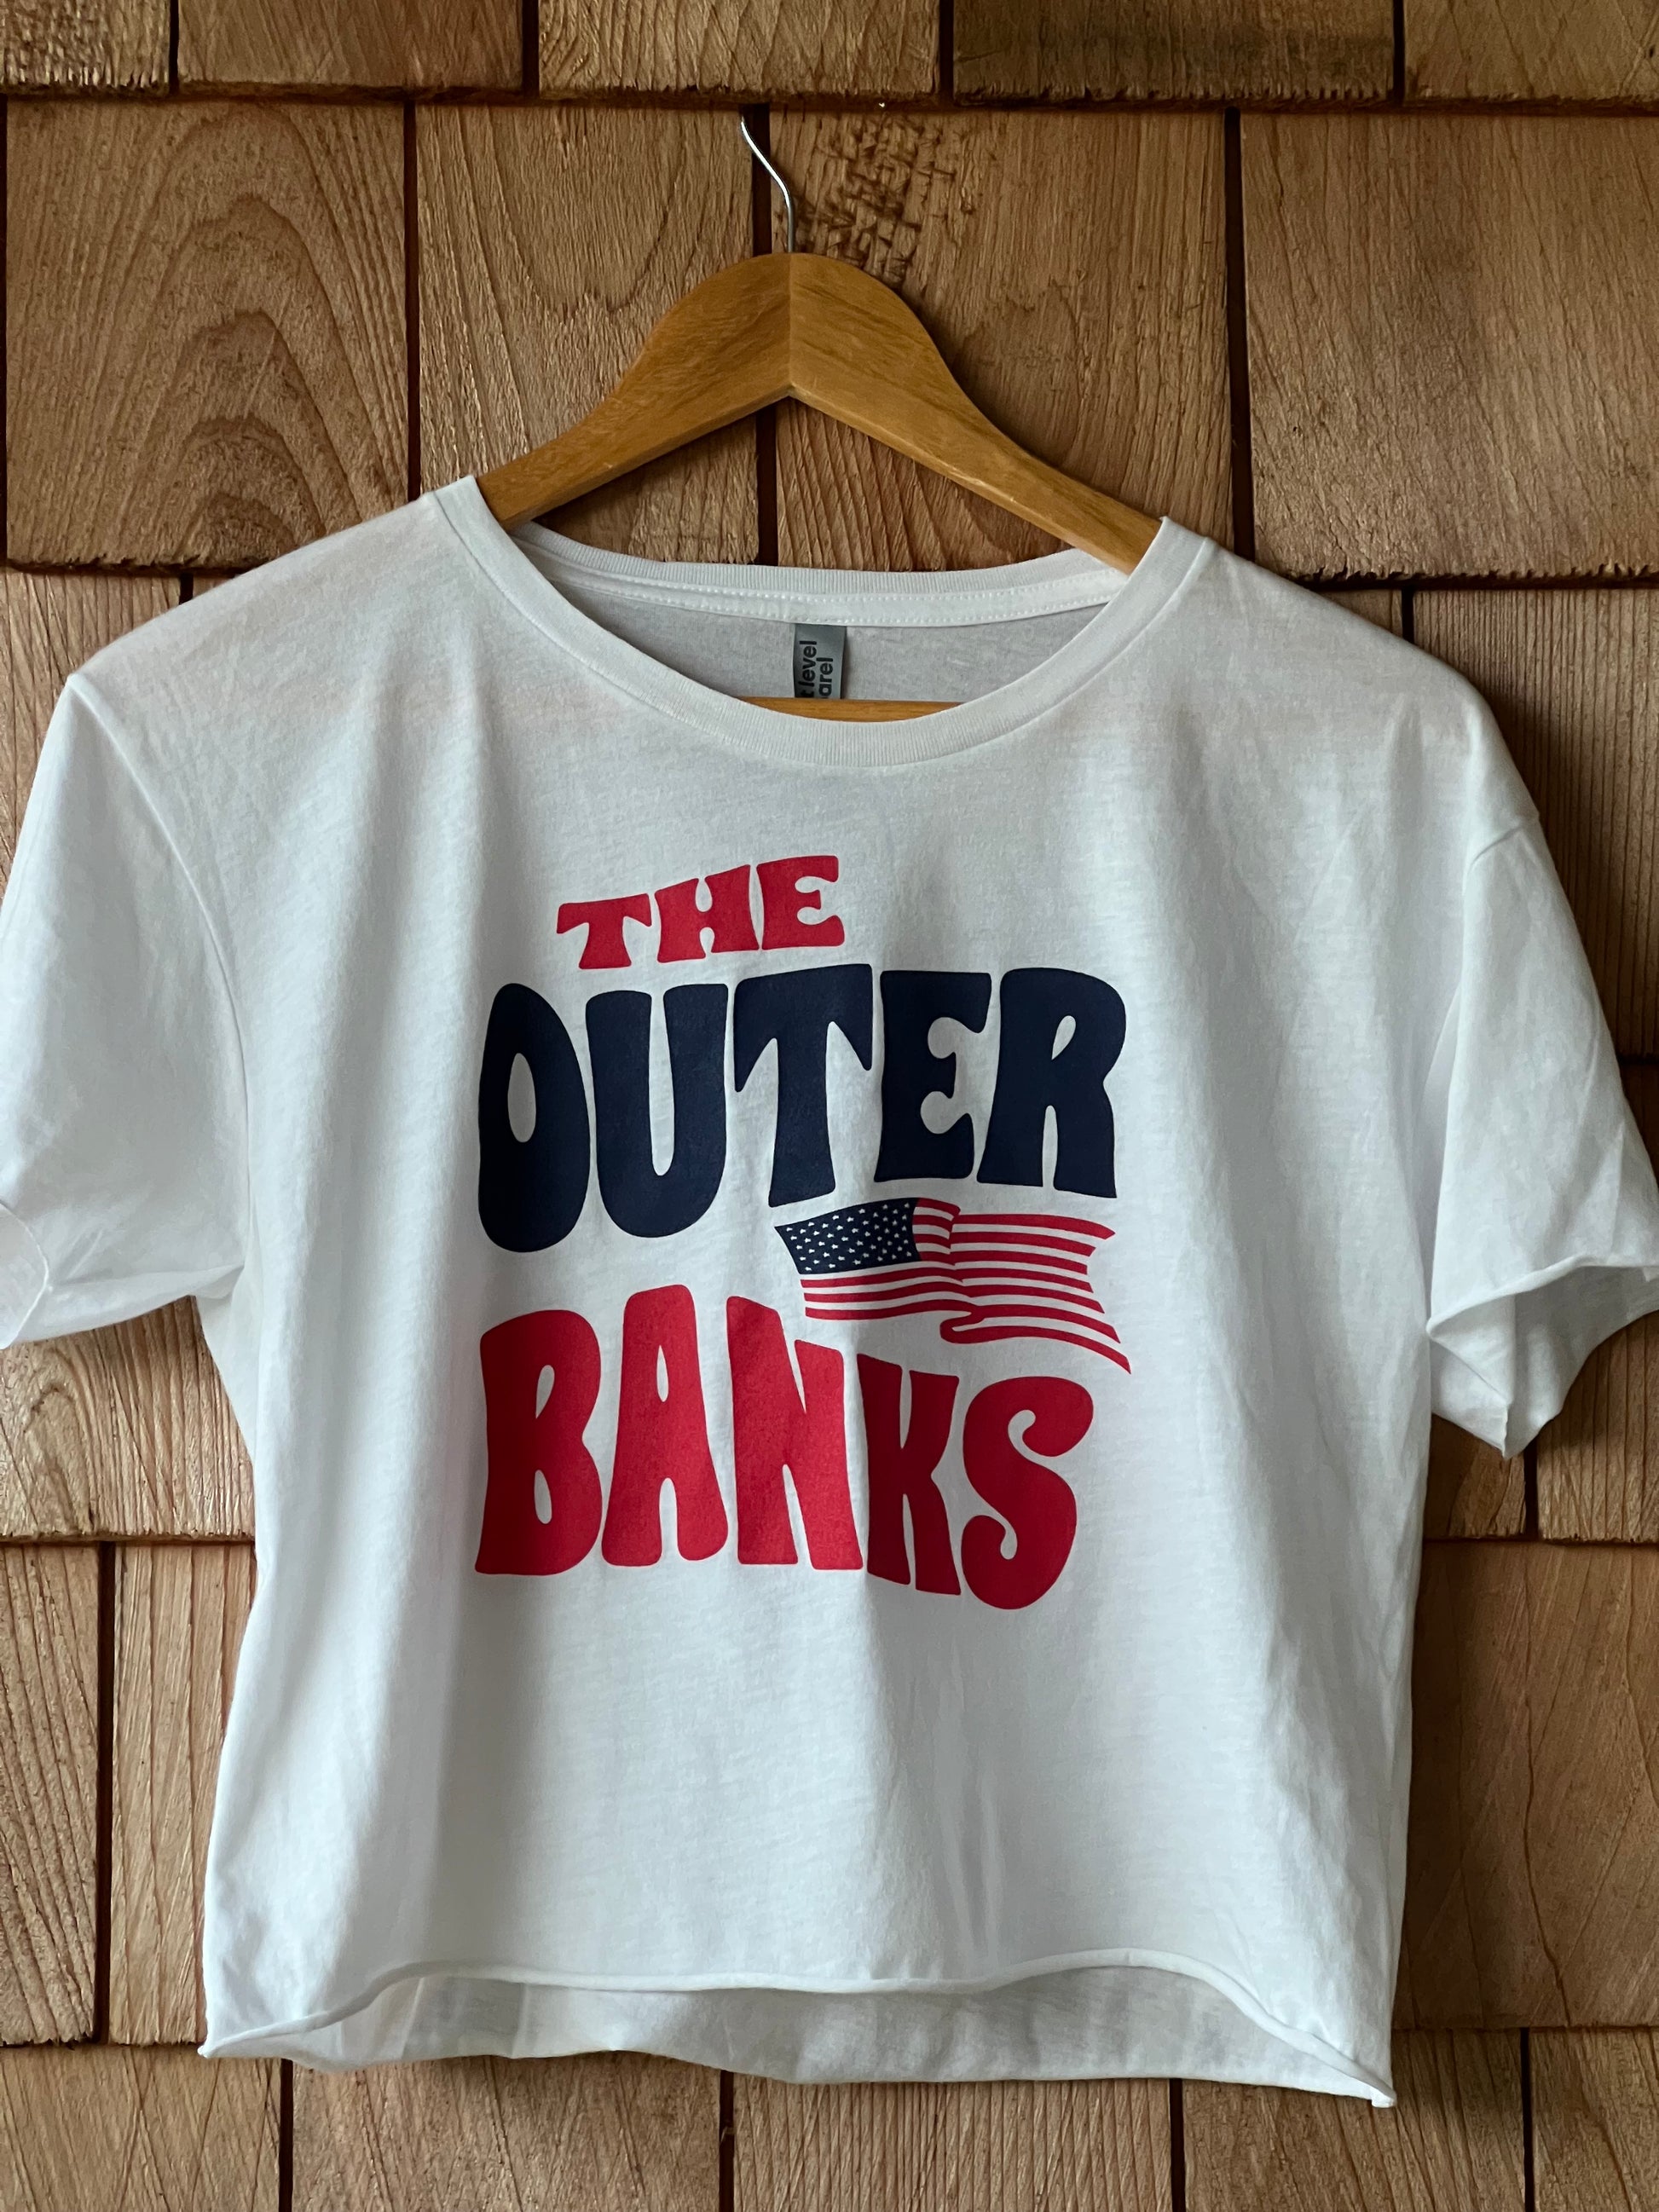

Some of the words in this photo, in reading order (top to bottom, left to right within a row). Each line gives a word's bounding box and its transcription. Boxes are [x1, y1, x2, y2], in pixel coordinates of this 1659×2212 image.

[798, 640, 818, 687] level
[816, 657, 834, 698] arel
[556, 855, 845, 970] THE
[477, 963, 1127, 1253] OUTER
[475, 1284, 1094, 1610] BANKS
